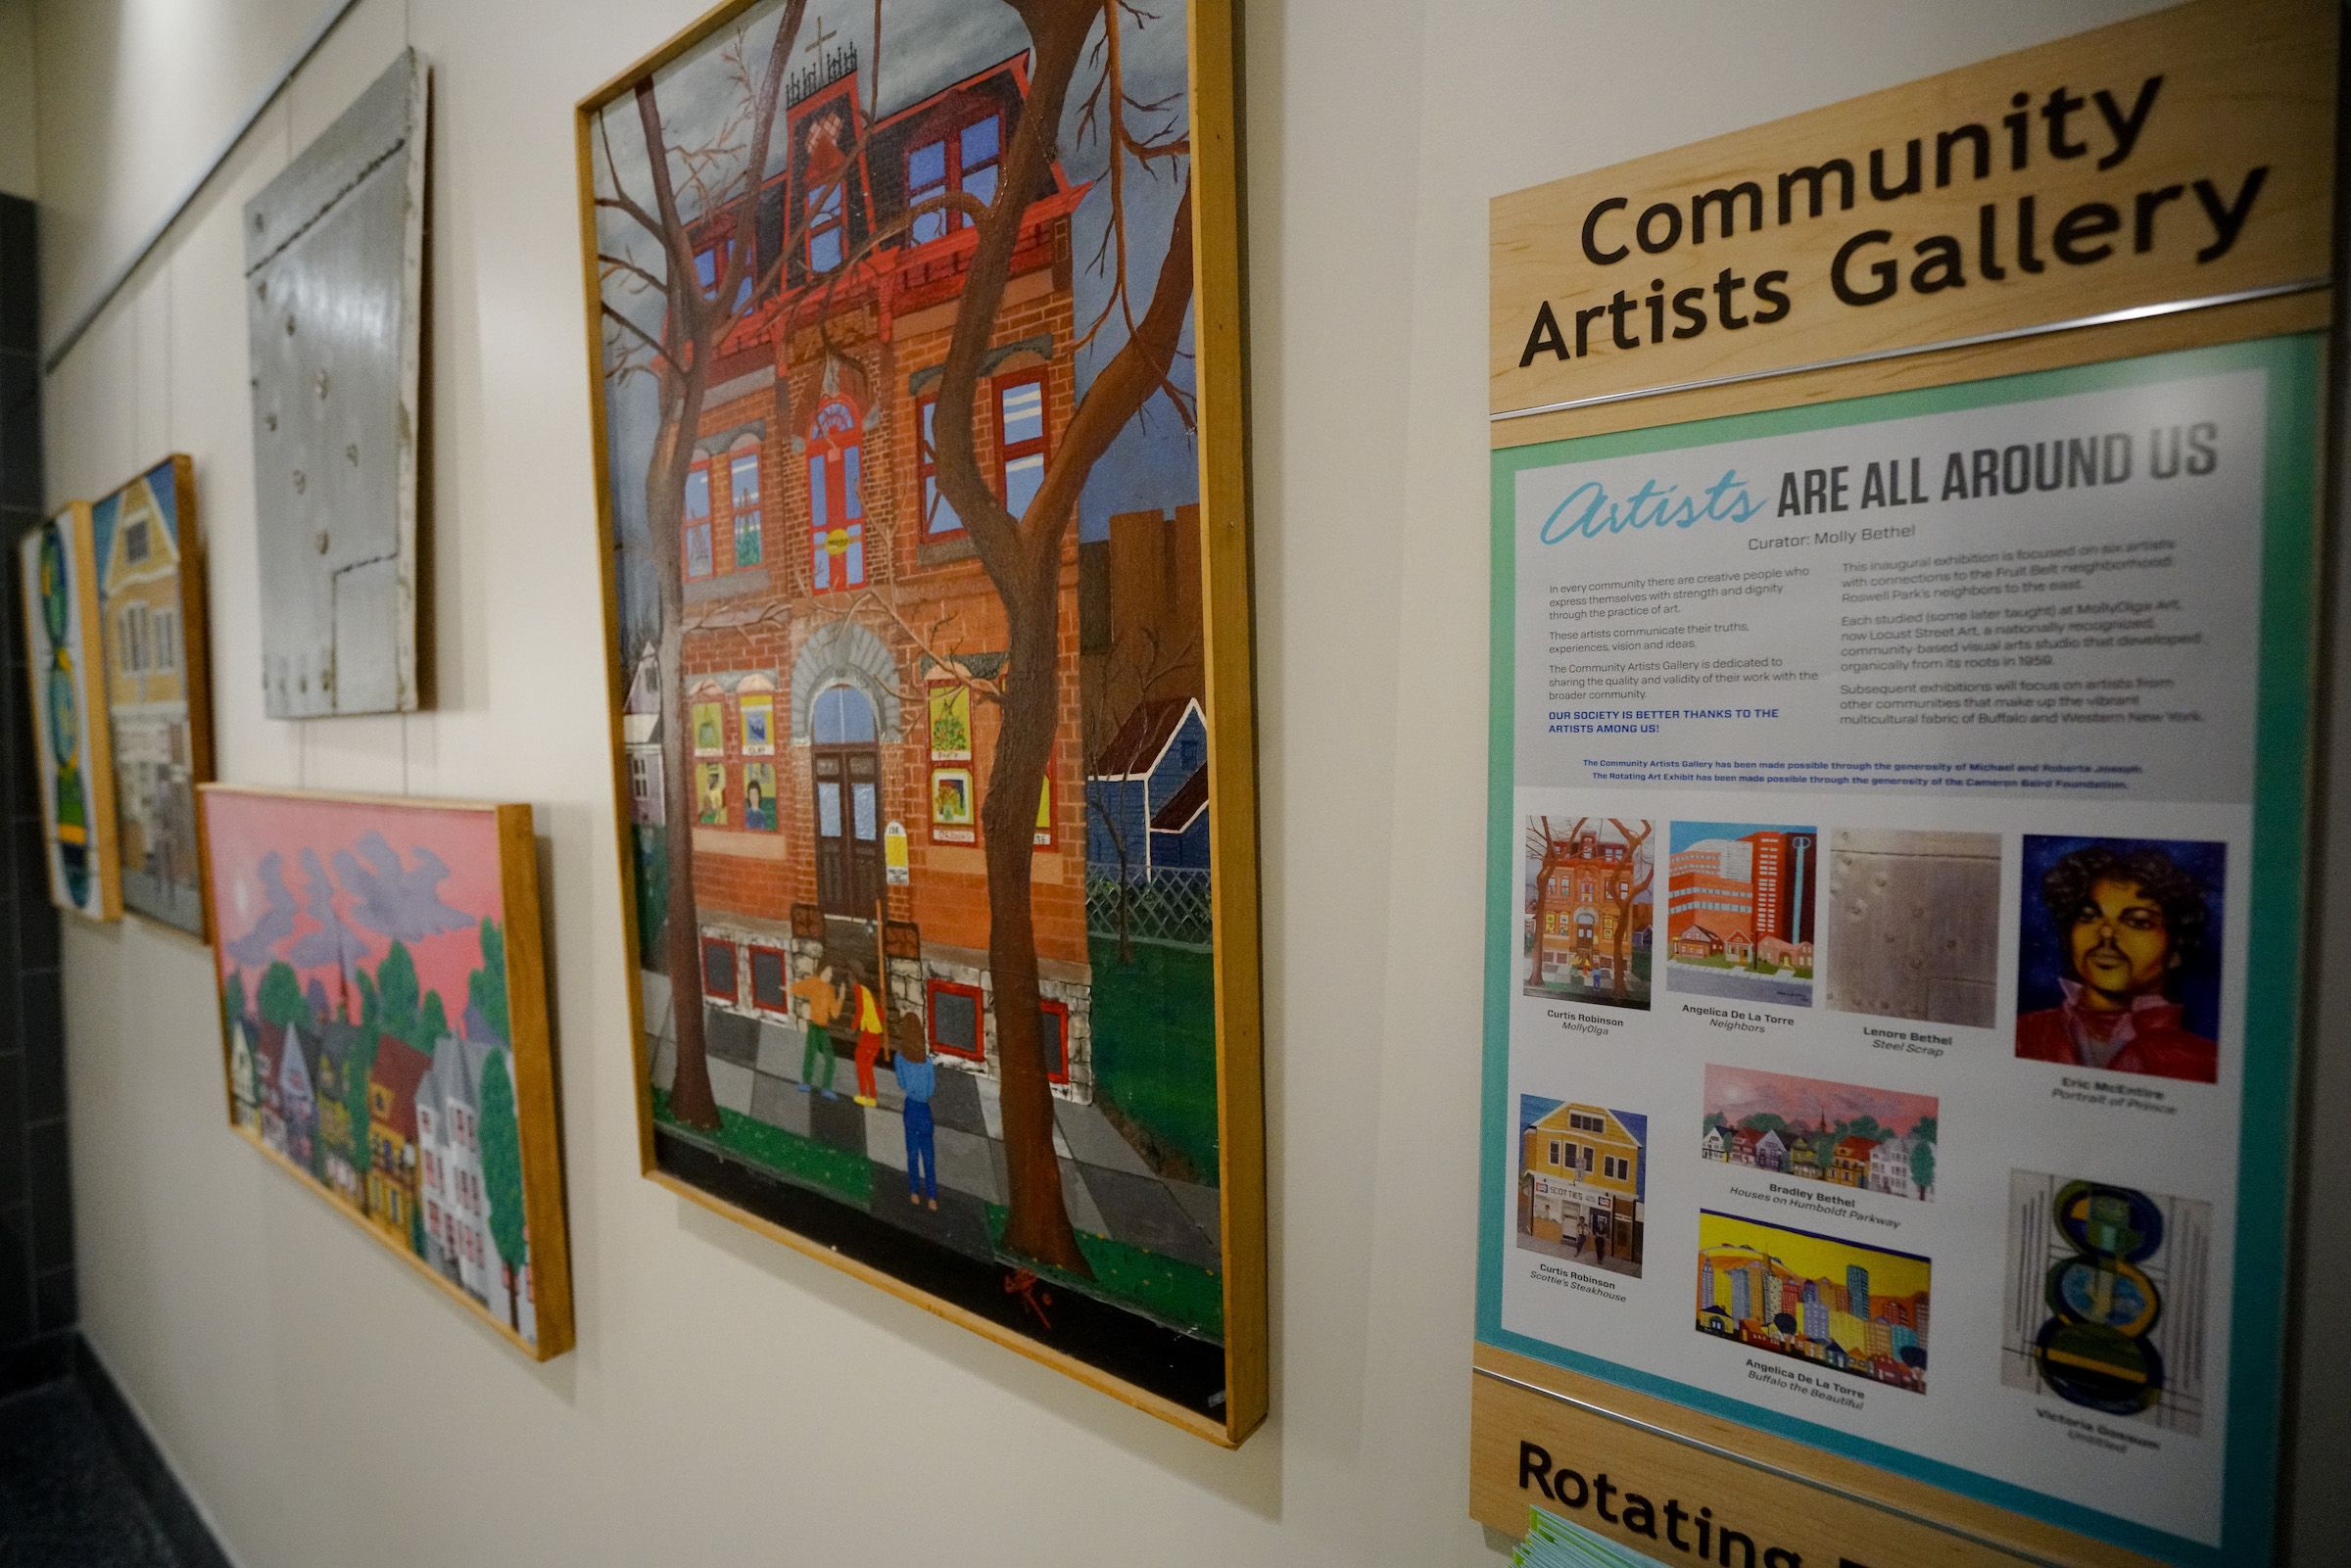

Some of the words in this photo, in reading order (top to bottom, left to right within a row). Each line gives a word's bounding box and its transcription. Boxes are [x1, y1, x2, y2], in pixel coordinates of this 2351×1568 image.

[1579, 74, 2164, 265] Community
[1518, 265, 1792, 367] Artists
[1830, 166, 2271, 308] Gallery
[1539, 469, 1769, 546] Artists
[1777, 465, 1849, 517] ARE
[1860, 456, 1929, 509] ALL
[1942, 432, 2133, 501] AROUND
[2148, 422, 2219, 481] US
[1748, 535, 1810, 550] Curator:
[1814, 530, 1857, 546] Molly
[1861, 524, 1916, 541] Bethel
[1550, 585, 1559, 594] In
[1560, 584, 1587, 594] every
[1589, 578, 1646, 591] community
[1648, 577, 1675, 587] there
[1697, 572, 1741, 584] creative
[1743, 569, 1783, 583] people
[1785, 567, 1810, 578] who
[1550, 597, 1587, 608] express
[1589, 593, 1648, 604] themselves
[1649, 590, 1671, 600] with
[1673, 587, 1718, 600] strength
[1720, 586, 1742, 596] and
[1744, 584, 1784, 596] dignity
[1550, 608, 1587, 621] through
[1589, 608, 1607, 618] the
[1607, 605, 1649, 619] practice
[1651, 604, 1661, 614] of
[1550, 631, 1579, 641] These
[1580, 629, 1610, 639] artists
[1612, 625, 1685, 638] communicate
[1687, 624, 1712, 634] their
[1611, 641, 1642, 651] vision
[1644, 640, 1663, 649] and
[1550, 664, 1567, 674] The
[1569, 662, 1626, 674] Community
[1628, 661, 1661, 671] Artists
[1662, 660, 1699, 672] Gallery
[1702, 659, 1710, 669] is
[1712, 657, 1769, 669] dedicated
[1771, 657, 1783, 667] to
[1549, 677, 1585, 689] sharing
[1587, 677, 1604, 686] the
[1606, 676, 1638, 688] quality
[1641, 675, 1661, 685] and
[1663, 674, 1701, 686] validity
[1703, 674, 1713, 683] of
[1714, 673, 1740, 683] their
[1743, 672, 1770, 682] work
[1773, 671, 1797, 682] with
[1799, 671, 1819, 681] the
[1549, 690, 1587, 700] broader
[1548, 711, 1571, 721] OUR
[1573, 711, 1620, 720] SOCIETY
[1622, 710, 1633, 720] IS
[1636, 710, 1681, 720] BETTER
[1683, 709, 1732, 719] THANKS
[1736, 709, 1751, 718] TO
[1753, 709, 1779, 718] THE
[1548, 725, 1594, 734] ARTISTS
[1597, 725, 1638, 734] AMONG
[1640, 725, 1659, 734] US!
[1600, 759, 1648, 768] Community
[1681, 759, 1712, 769] Gallery
[1759, 760, 1785, 769] made
[1787, 761, 1828, 771] possible
[1831, 761, 1872, 772] through
[1895, 762, 1951, 773] generosity
[1955, 762, 1967, 771] of
[1608, 772, 1646, 782] Rotating
[1714, 773, 1736, 782] been
[1767, 775, 1808, 784] possible
[1810, 775, 1849, 784] through
[1871, 776, 1930, 786] generosity
[1945, 777, 1961, 785] the
[1547, 1009, 1576, 1022] Curtis
[1578, 1013, 1624, 1027] Robinson
[1682, 1004, 1728, 1021] Angelica
[1731, 1010, 1746, 1021] De
[1748, 1012, 1762, 1022] La
[1764, 1014, 1795, 1026] Torre
[1561, 1022, 1609, 1036] MollyOlga
[1709, 1018, 1766, 1035] Neighbors
[1863, 1026, 1907, 1042] Lenore
[1909, 1031, 1953, 1046] Bethel
[1872, 1039, 1904, 1054] Steel
[1905, 1042, 1944, 1059] Scrap
[1769, 1183, 1813, 1201] Bradley
[1816, 1192, 1855, 1209] Bethel
[1730, 1186, 1771, 1203] Houses
[1772, 1196, 1788, 1206] on
[1789, 1198, 1847, 1217] Humboldt
[1848, 1211, 1902, 1229] Parkway
[1530, 1270, 1569, 1288] Scottie's
[1570, 1281, 1627, 1303] Steakhouse
[1540, 1263, 1568, 1277] Curtis
[1570, 1271, 1615, 1290] Robinson
[1746, 1358, 1795, 1379] Angelica
[1798, 1372, 1813, 1384] De
[1816, 1378, 1830, 1390] La
[1833, 1382, 1865, 1400] Torre
[1748, 1370, 1788, 1389] Buffalo
[1790, 1382, 1808, 1395] the
[1810, 1388, 1865, 1411] Beautiful
